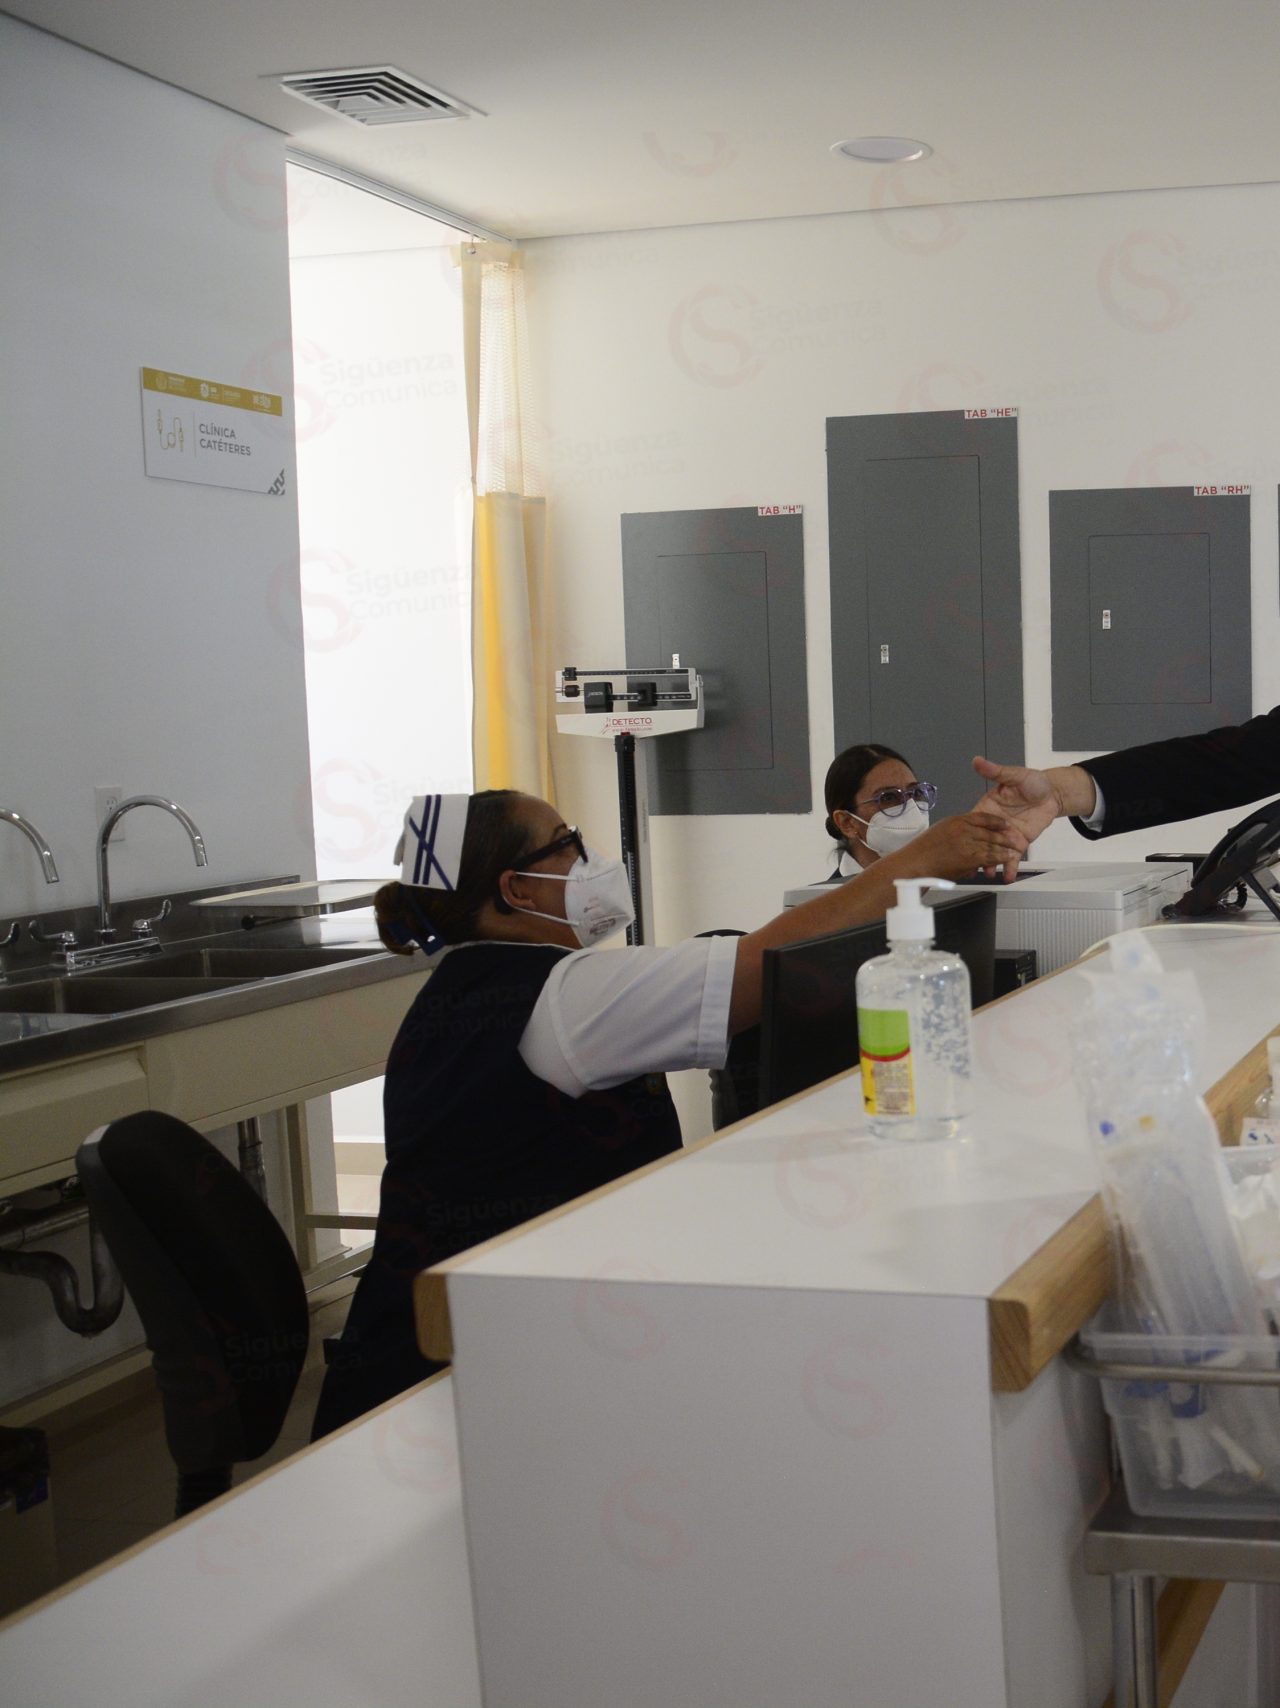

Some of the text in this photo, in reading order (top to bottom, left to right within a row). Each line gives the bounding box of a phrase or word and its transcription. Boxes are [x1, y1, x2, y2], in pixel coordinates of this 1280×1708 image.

[966, 407, 1018, 418] TAB “HE”
[199, 422, 237, 440] CLÍNICA
[199, 438, 252, 457] CATÉTERES
[1195, 485, 1250, 495] TAB “RH”
[759, 506, 780, 515] TAB
[612, 717, 653, 726] DETECTO
